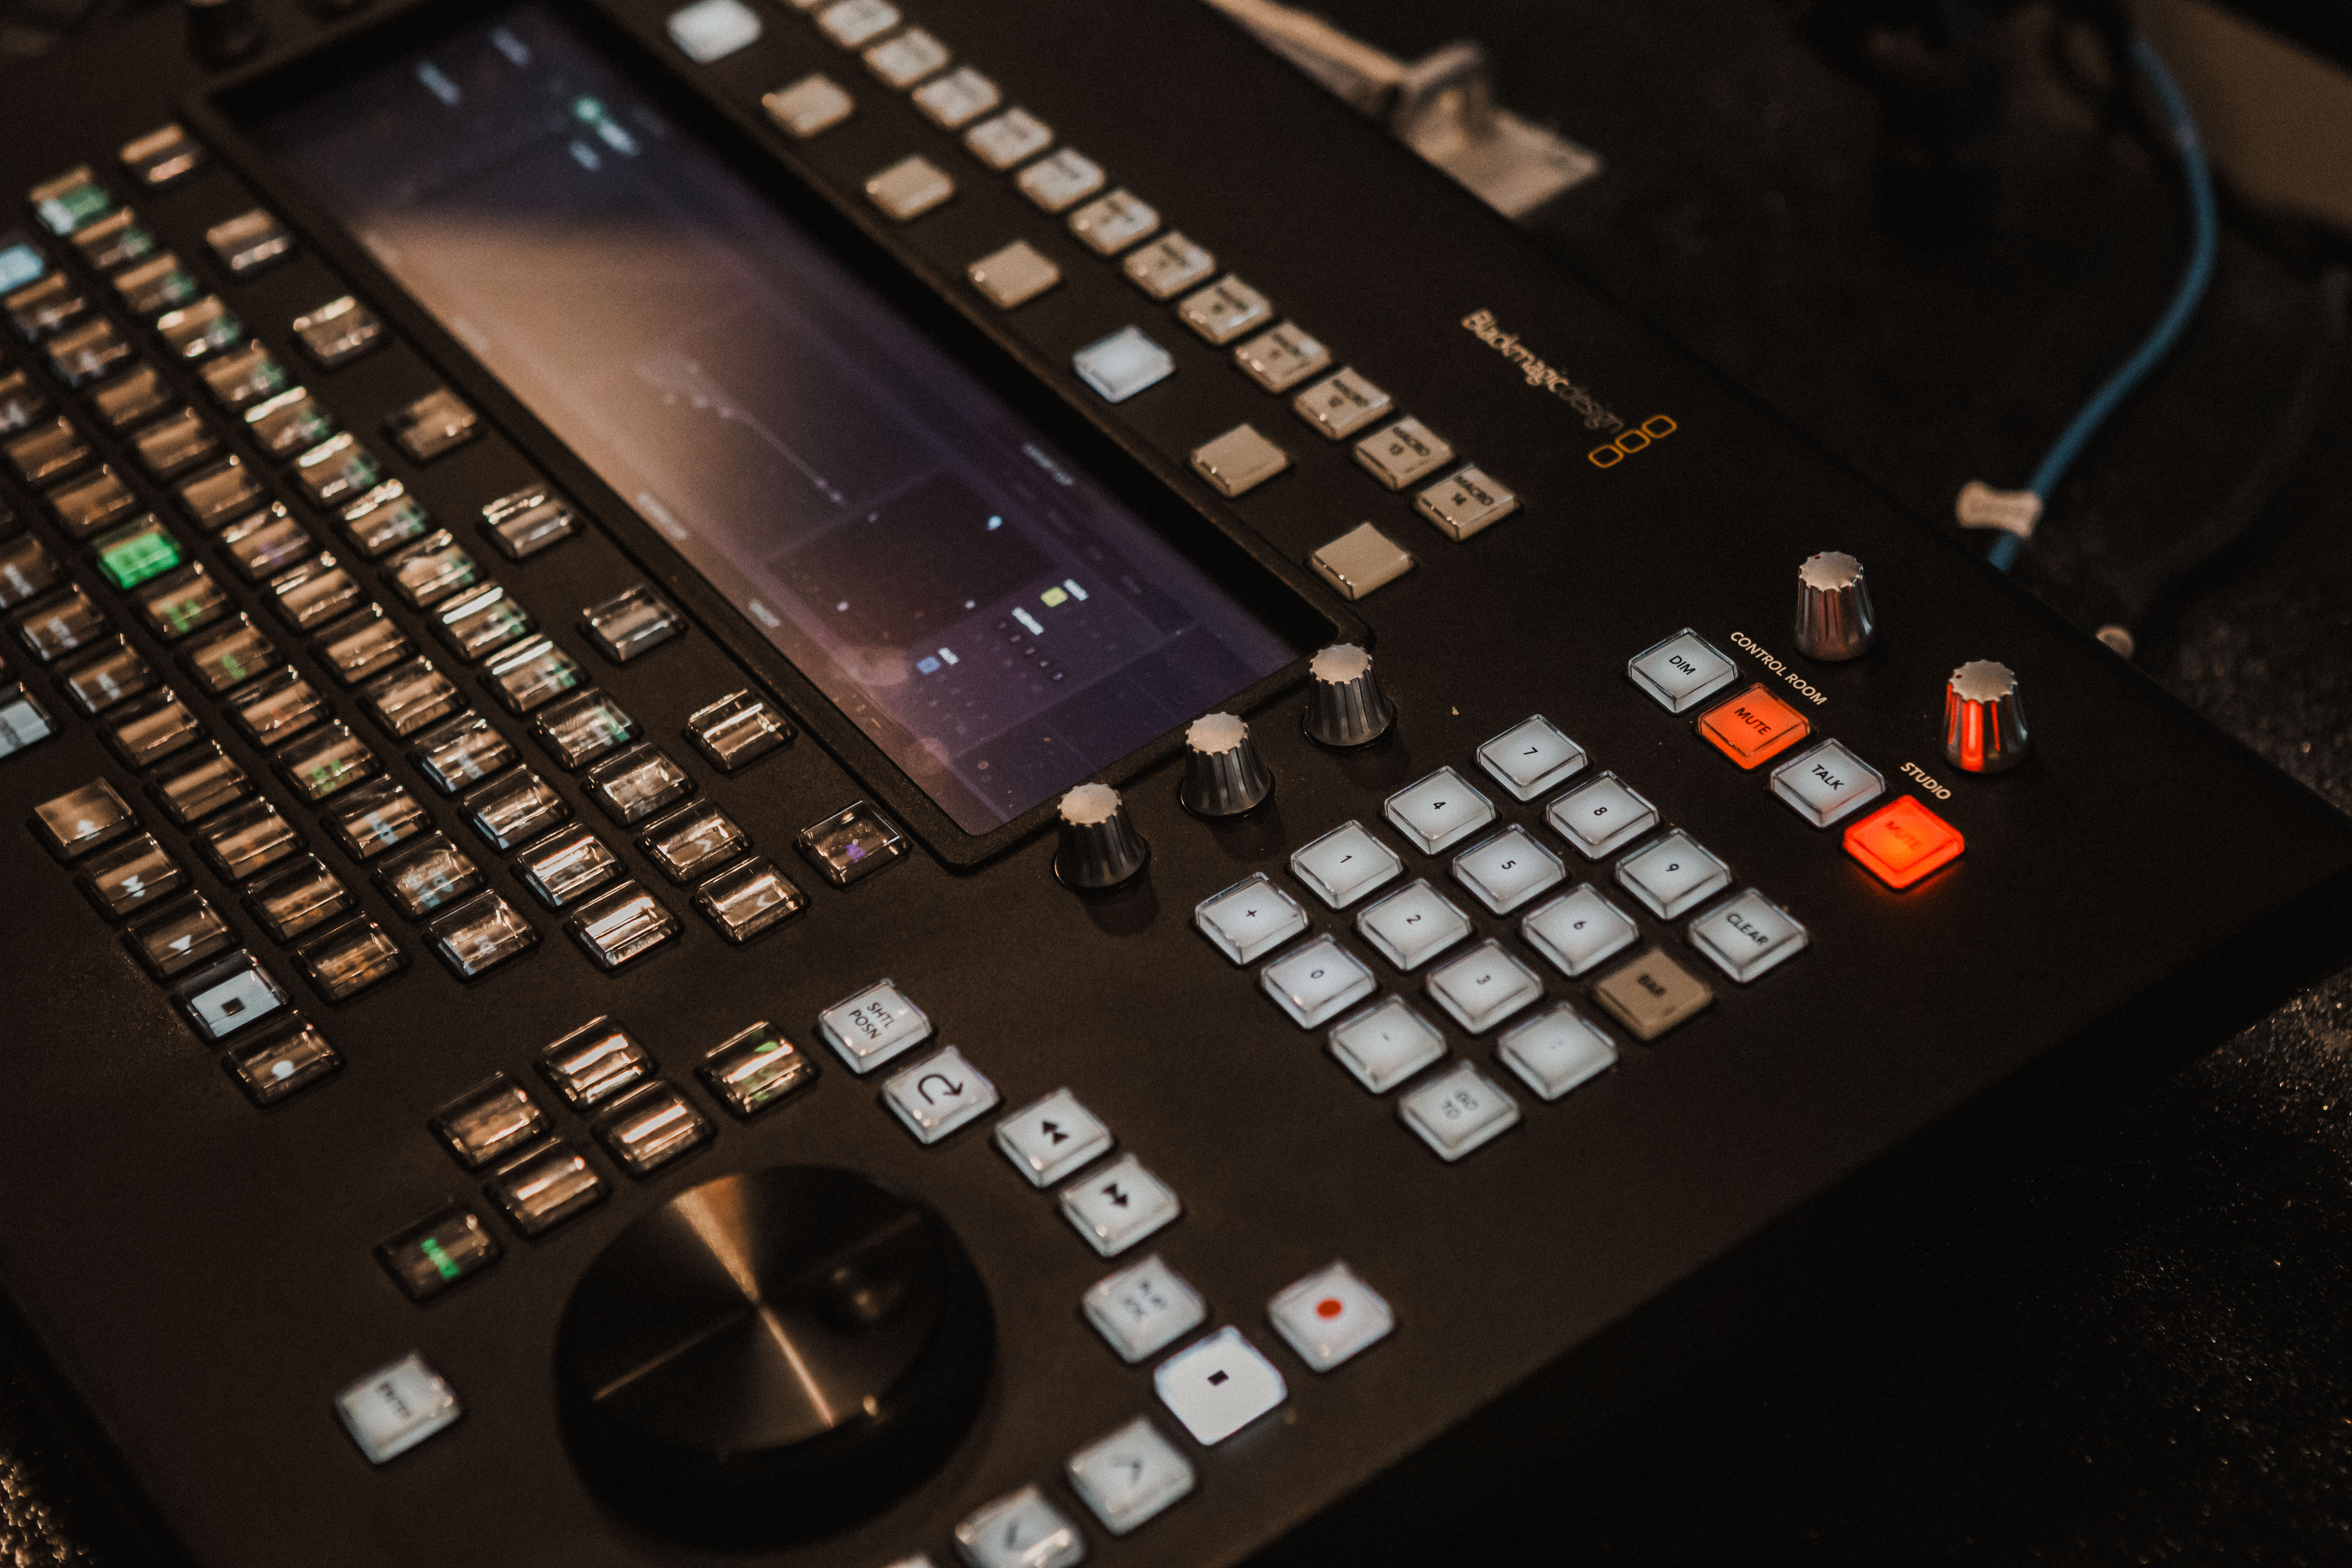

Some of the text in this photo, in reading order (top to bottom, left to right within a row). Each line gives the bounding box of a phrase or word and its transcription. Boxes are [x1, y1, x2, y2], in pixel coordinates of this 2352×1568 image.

[1668, 655, 1696, 675] DIM
[1730, 631, 1828, 705] CONTROL ROOM
[1734, 707, 1771, 735] MUTE
[1523, 746, 1538, 756] 7
[1812, 764, 1845, 790] TALK
[1900, 762, 1951, 800] STUDIO
[1433, 801, 1446, 810] 4
[1593, 806, 1608, 816] 8
[1340, 855, 1352, 864] 1
[1501, 859, 1517, 870] 5
[1666, 863, 1680, 872] 9
[1406, 914, 1422, 924] 2
[1573, 921, 1587, 930] 6
[1726, 913, 1769, 945] CLEAR
[1310, 969, 1324, 979] 0
[1476, 973, 1491, 985] 3
[867, 1001, 894, 1029] SHTL
[849, 1009, 882, 1039] POSN
